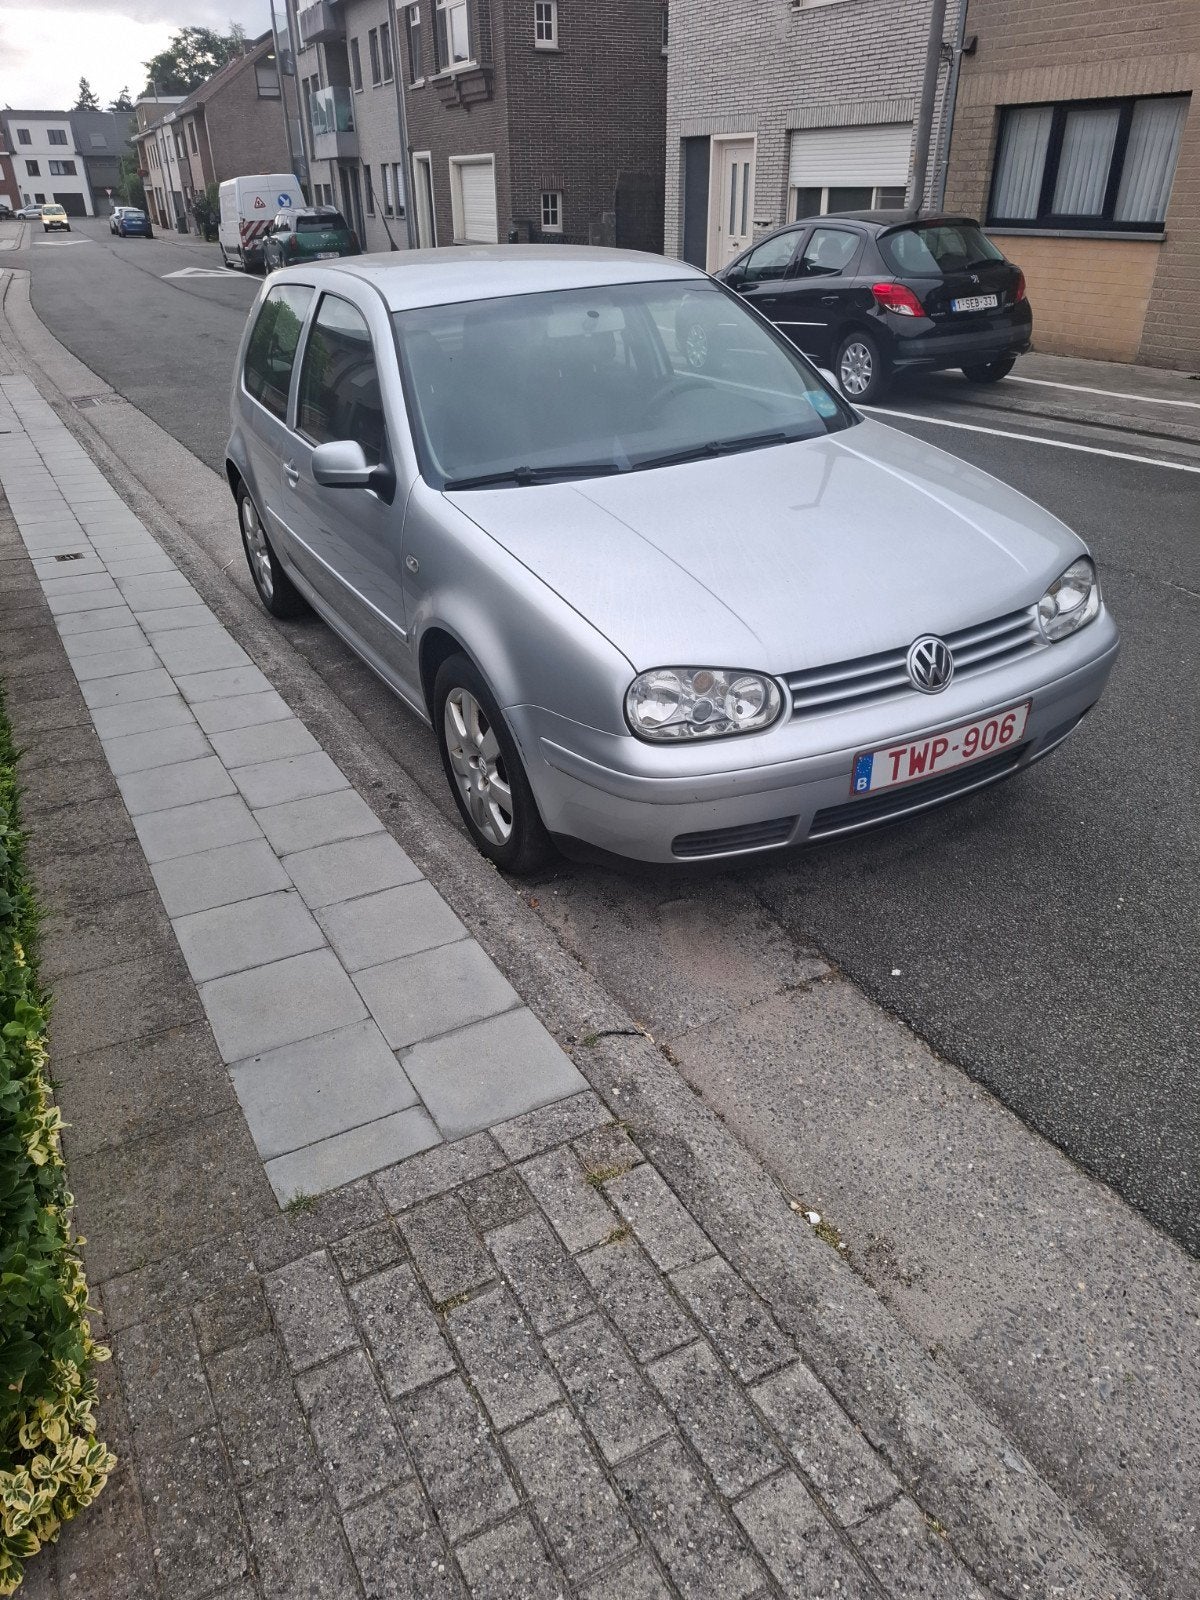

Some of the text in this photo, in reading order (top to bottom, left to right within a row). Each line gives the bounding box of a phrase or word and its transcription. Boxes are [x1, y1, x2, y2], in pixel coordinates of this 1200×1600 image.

[957, 295, 997, 310] 1-SEB-331
[889, 713, 1016, 781] TWP-906
[856, 777, 868, 791] B
